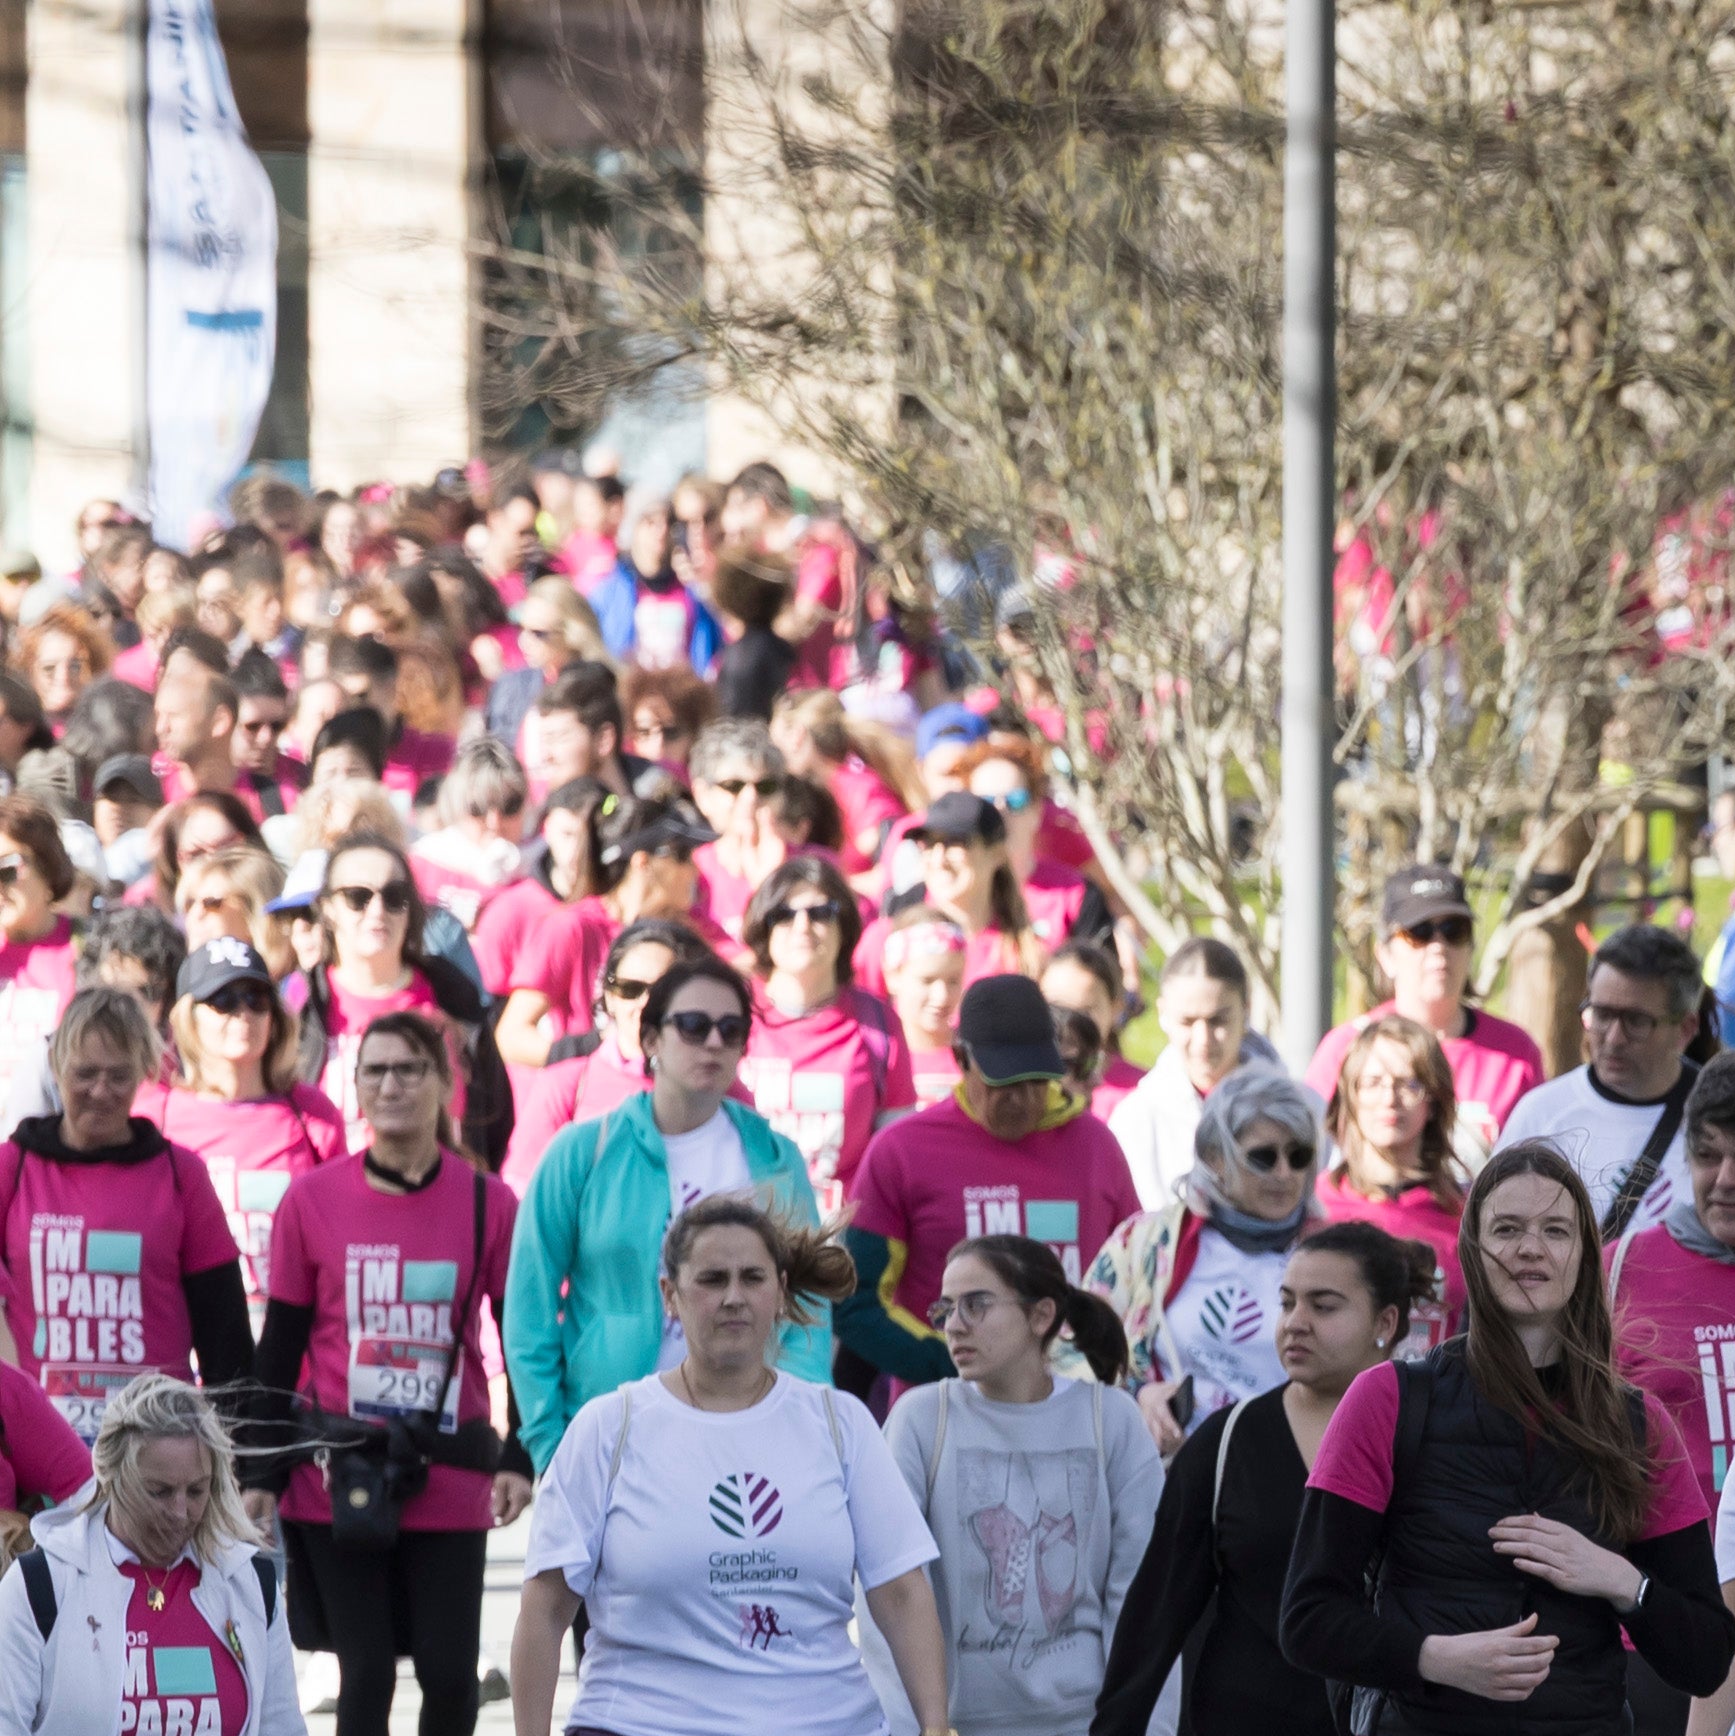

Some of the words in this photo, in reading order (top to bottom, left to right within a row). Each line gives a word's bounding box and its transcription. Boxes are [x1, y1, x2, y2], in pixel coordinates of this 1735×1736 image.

[46, 1272, 143, 1320] PARA
[48, 1317, 145, 1364] BLES
[709, 1549, 776, 1568] Graphic
[710, 1565, 798, 1584] Packaging
